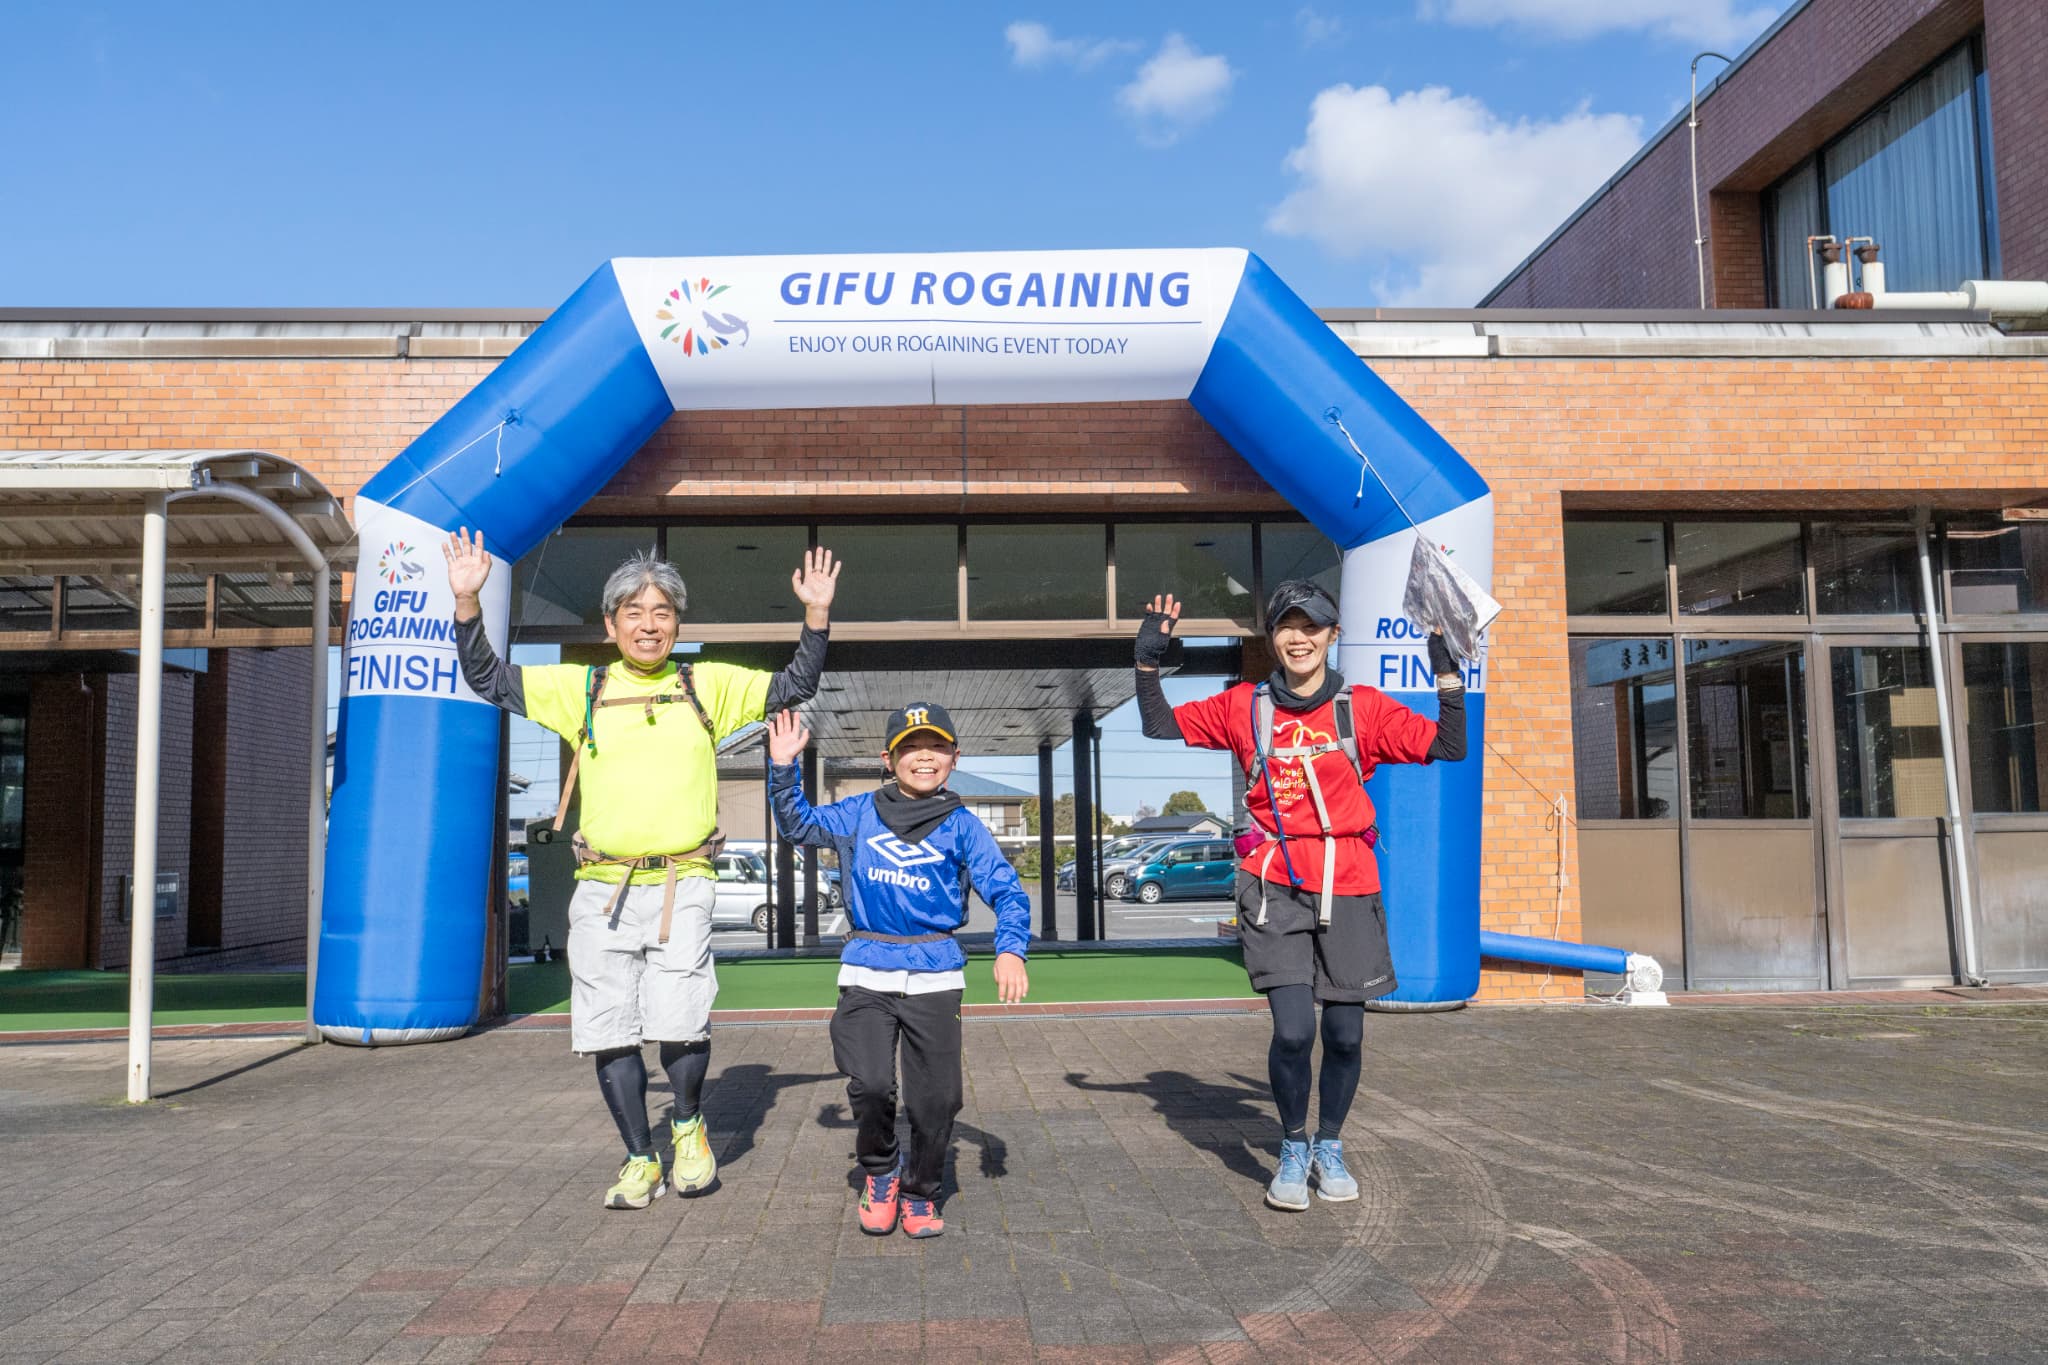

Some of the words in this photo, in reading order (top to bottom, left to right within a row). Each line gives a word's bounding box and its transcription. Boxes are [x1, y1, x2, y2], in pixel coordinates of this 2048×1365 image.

[780, 271, 896, 306] GIFU
[910, 271, 1190, 307] ROGAINING
[789, 336, 847, 353] ENJOY
[852, 335, 892, 352] OUR
[897, 335, 999, 353] ROGAINING
[1004, 337, 1061, 354] EVENT
[1065, 337, 1129, 354] TODAY
[374, 590, 428, 614] GIFU
[348, 654, 459, 694] FINISH
[1379, 654, 1481, 689] FINH
[868, 867, 931, 891] umbro
